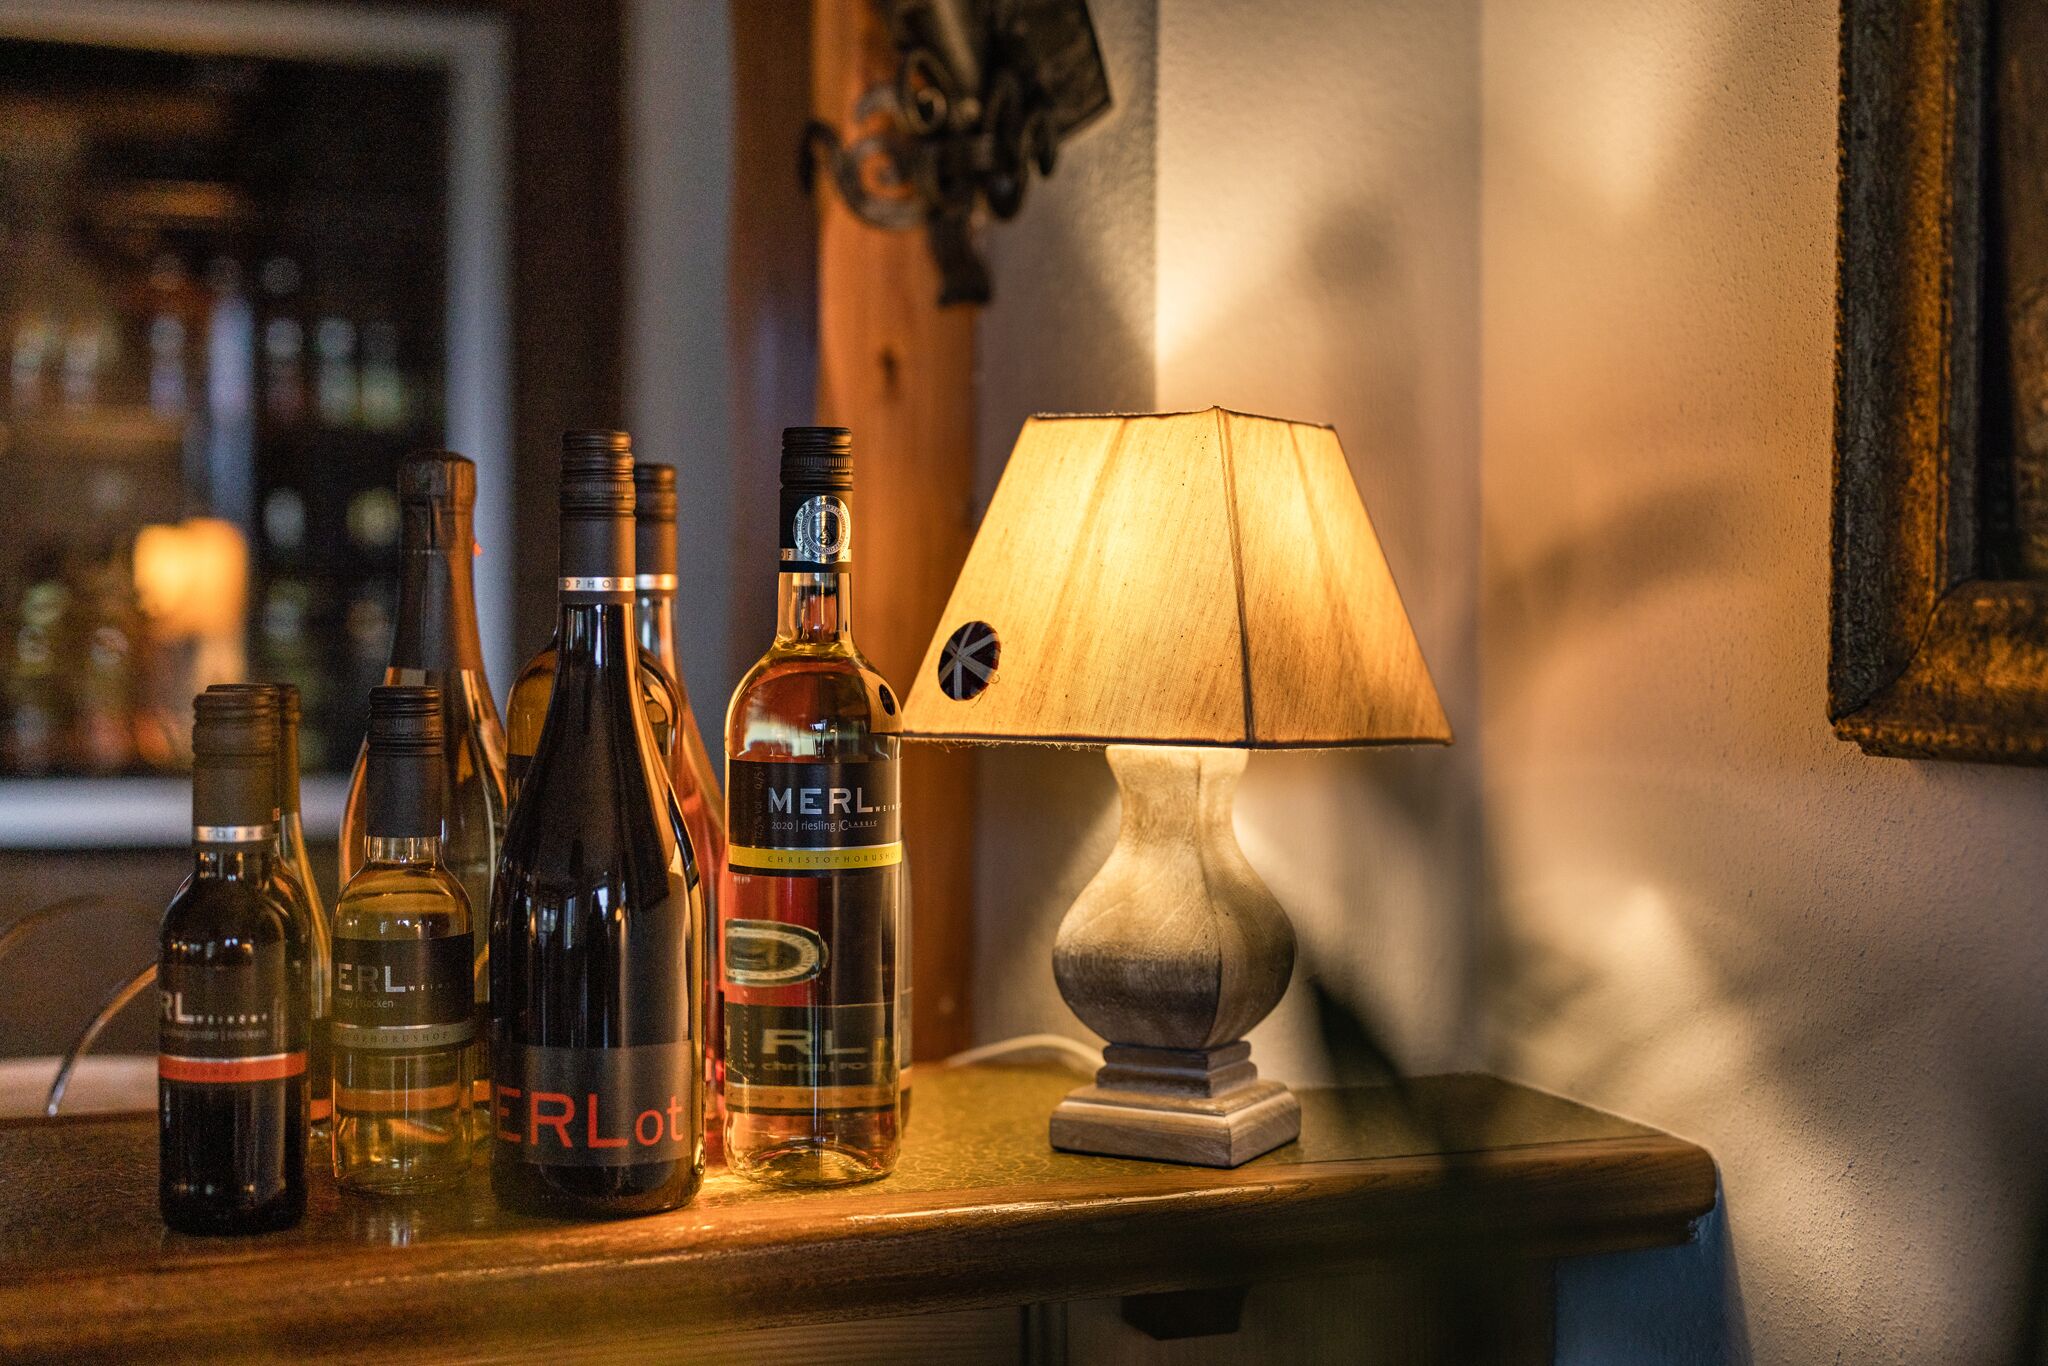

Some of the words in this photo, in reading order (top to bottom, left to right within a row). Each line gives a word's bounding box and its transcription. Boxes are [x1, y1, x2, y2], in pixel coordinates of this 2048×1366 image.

[768, 787, 873, 815] MERL
[771, 821, 793, 831] 2020
[801, 820, 836, 832] riesling
